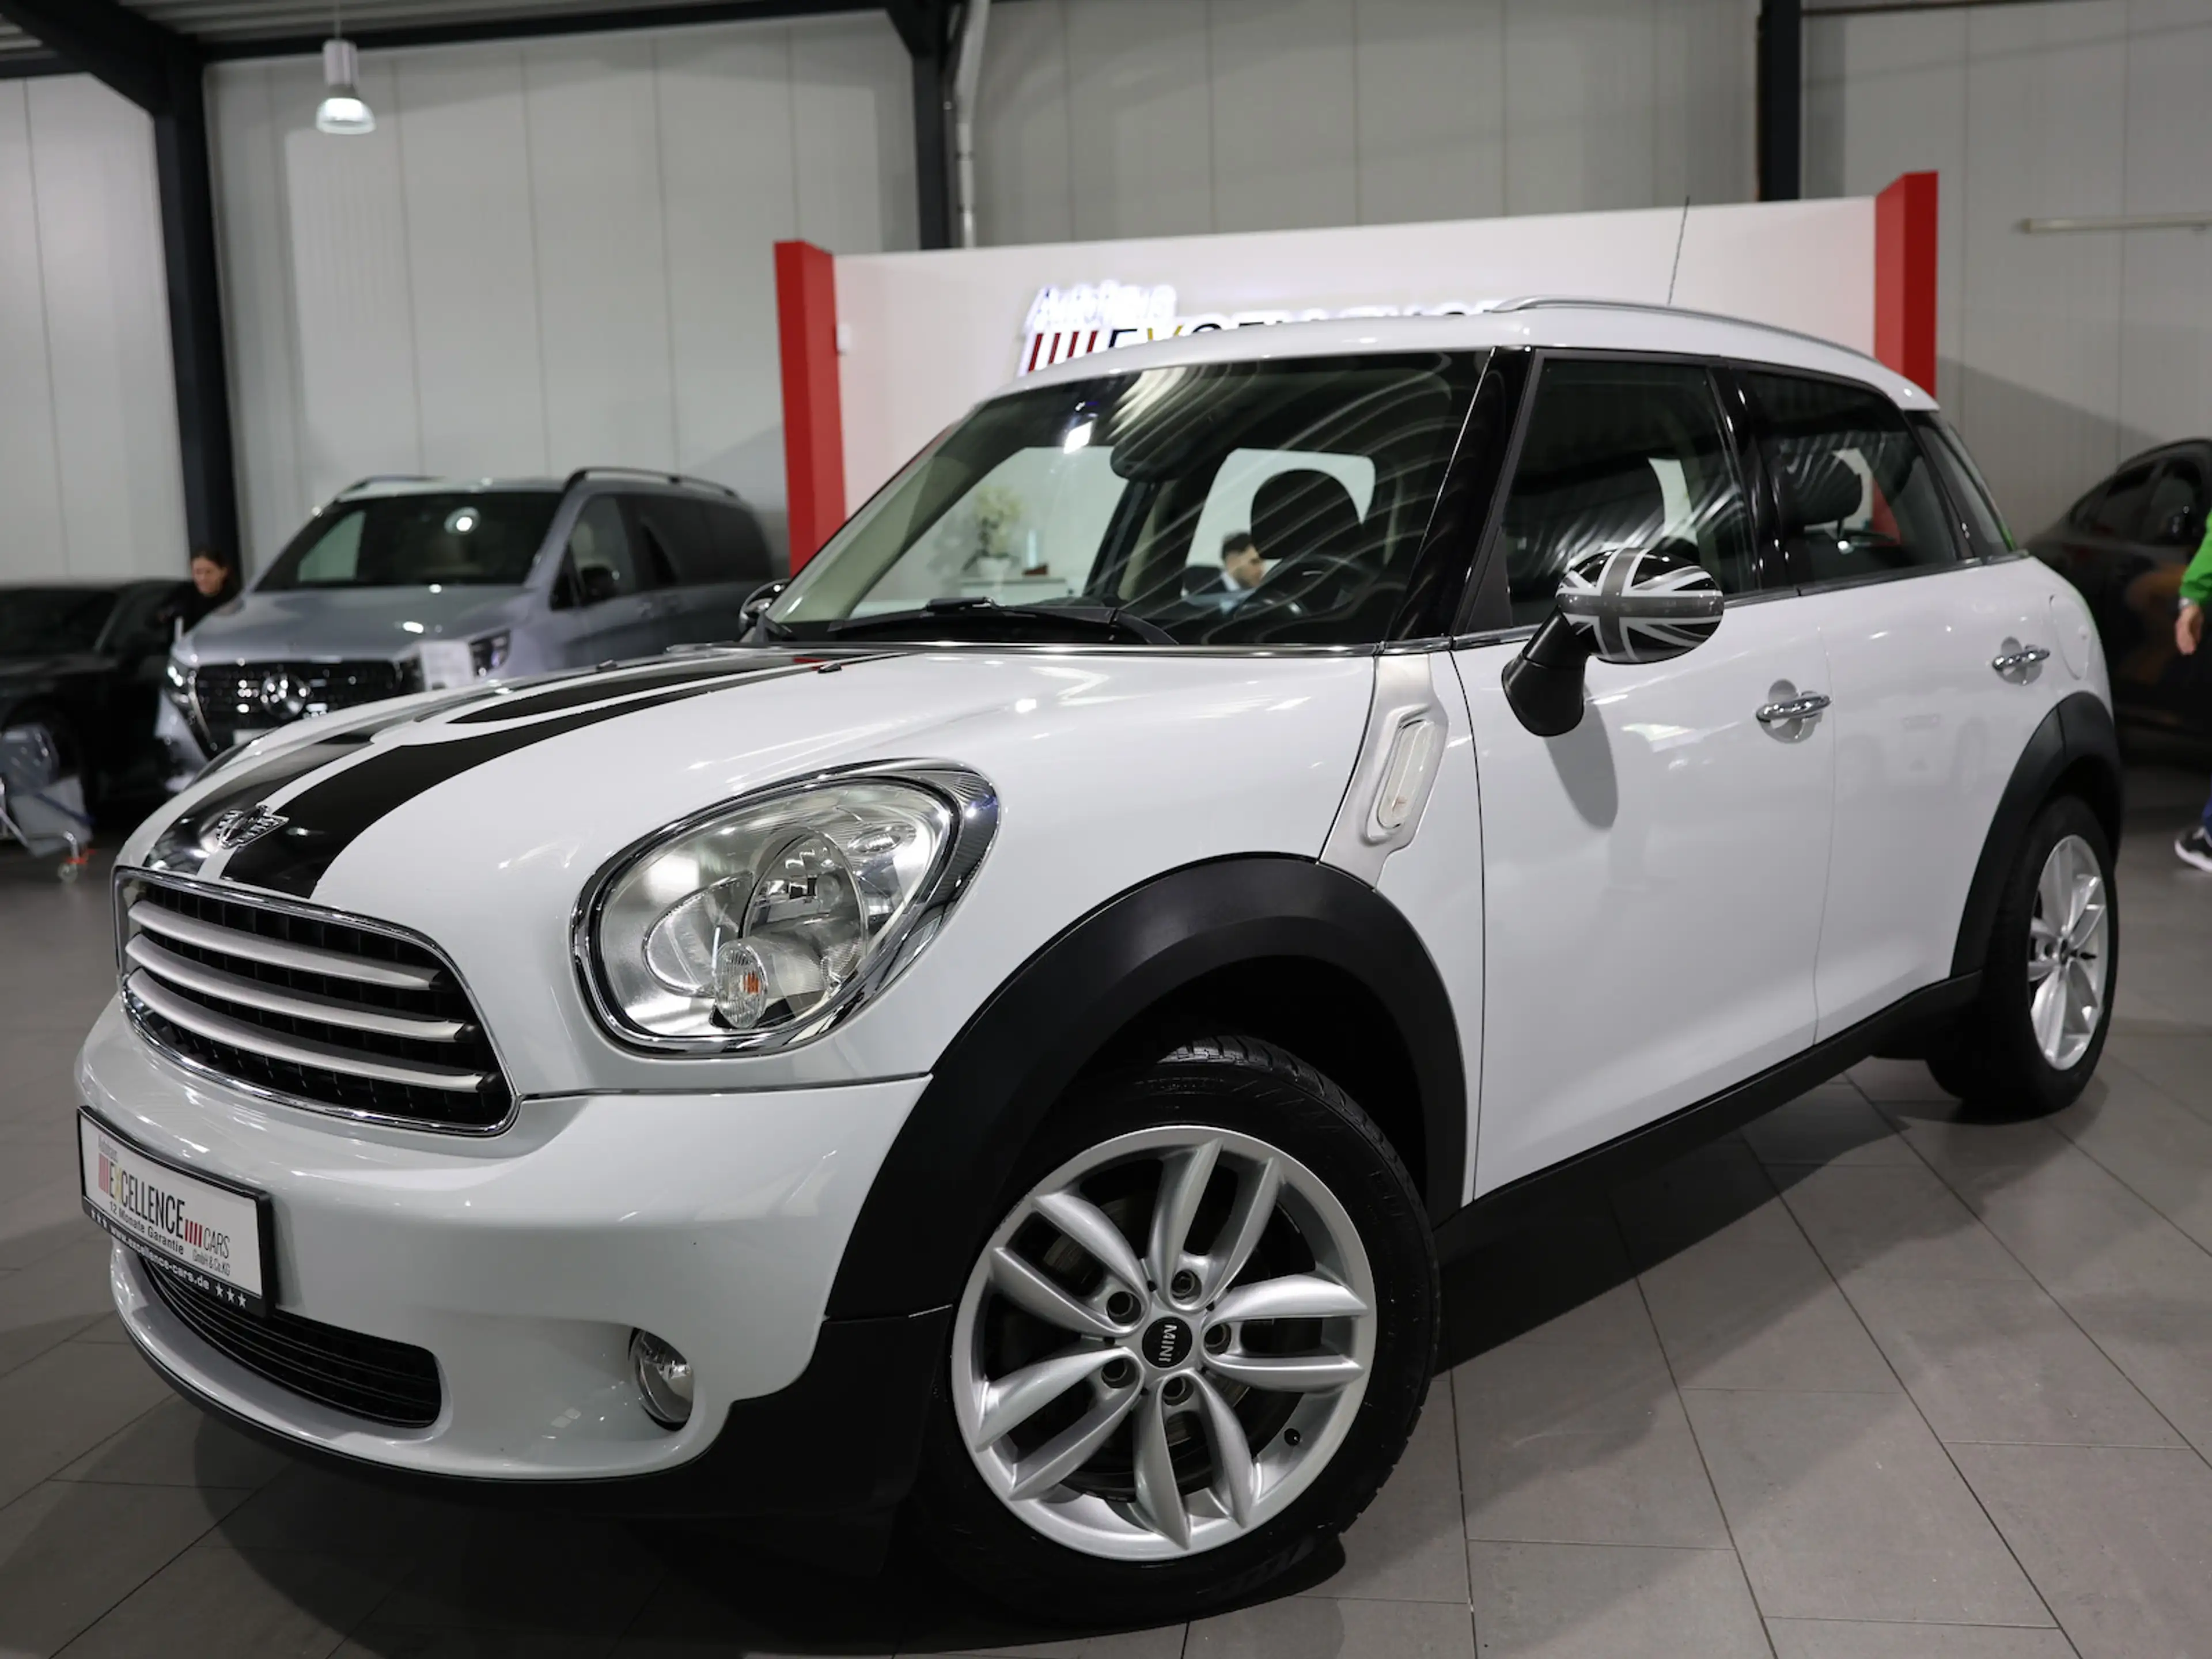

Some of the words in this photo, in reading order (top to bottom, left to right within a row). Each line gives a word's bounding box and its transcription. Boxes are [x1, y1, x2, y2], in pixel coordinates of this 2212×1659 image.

[109, 1161, 185, 1239] EXCELLENCE
[203, 1227, 230, 1259] CARS
[119, 1207, 146, 1233] Monate
[148, 1226, 184, 1255] Garantie
[1158, 1324, 1178, 1362] MINI
